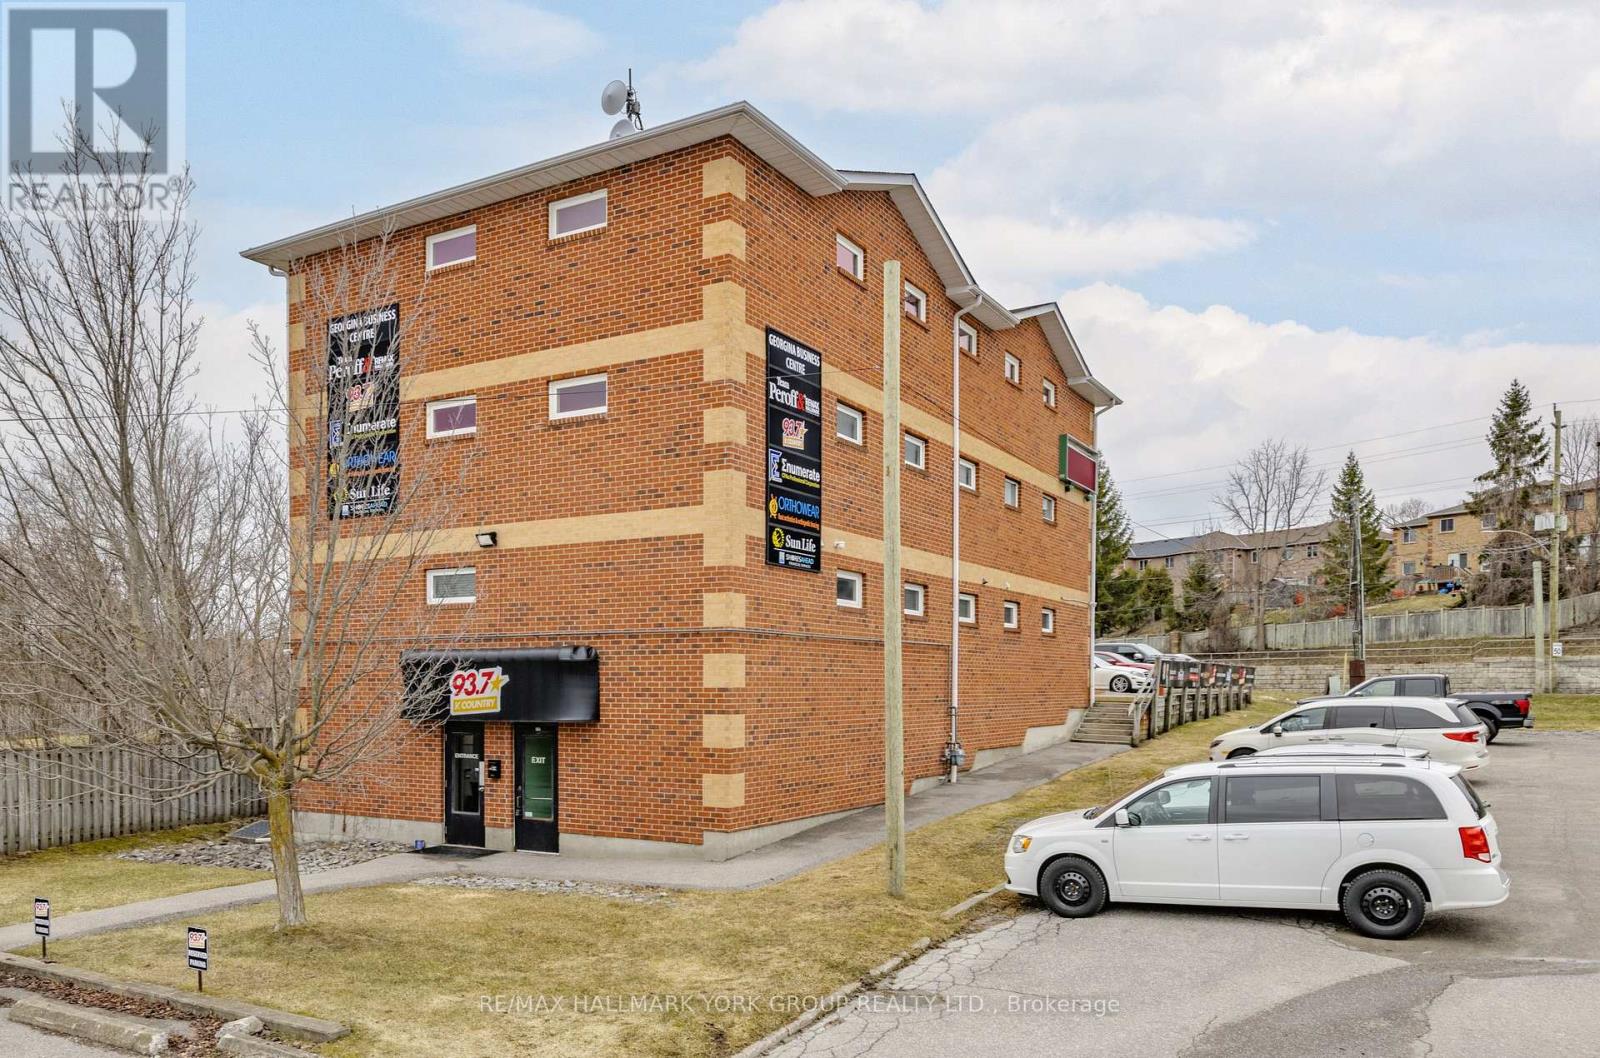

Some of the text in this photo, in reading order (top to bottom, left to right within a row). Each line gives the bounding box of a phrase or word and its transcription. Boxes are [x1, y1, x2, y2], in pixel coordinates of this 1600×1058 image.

[768, 333, 821, 367] GEORGINA BUSINESS
[785, 356, 806, 375] CENTRE
[778, 496, 820, 519] ORTHOWEAR
[785, 534, 816, 553] Sun Life
[1553, 647, 1562, 655] 50
[452, 671, 495, 696] 93.7
[531, 756, 546, 764] EXIT
